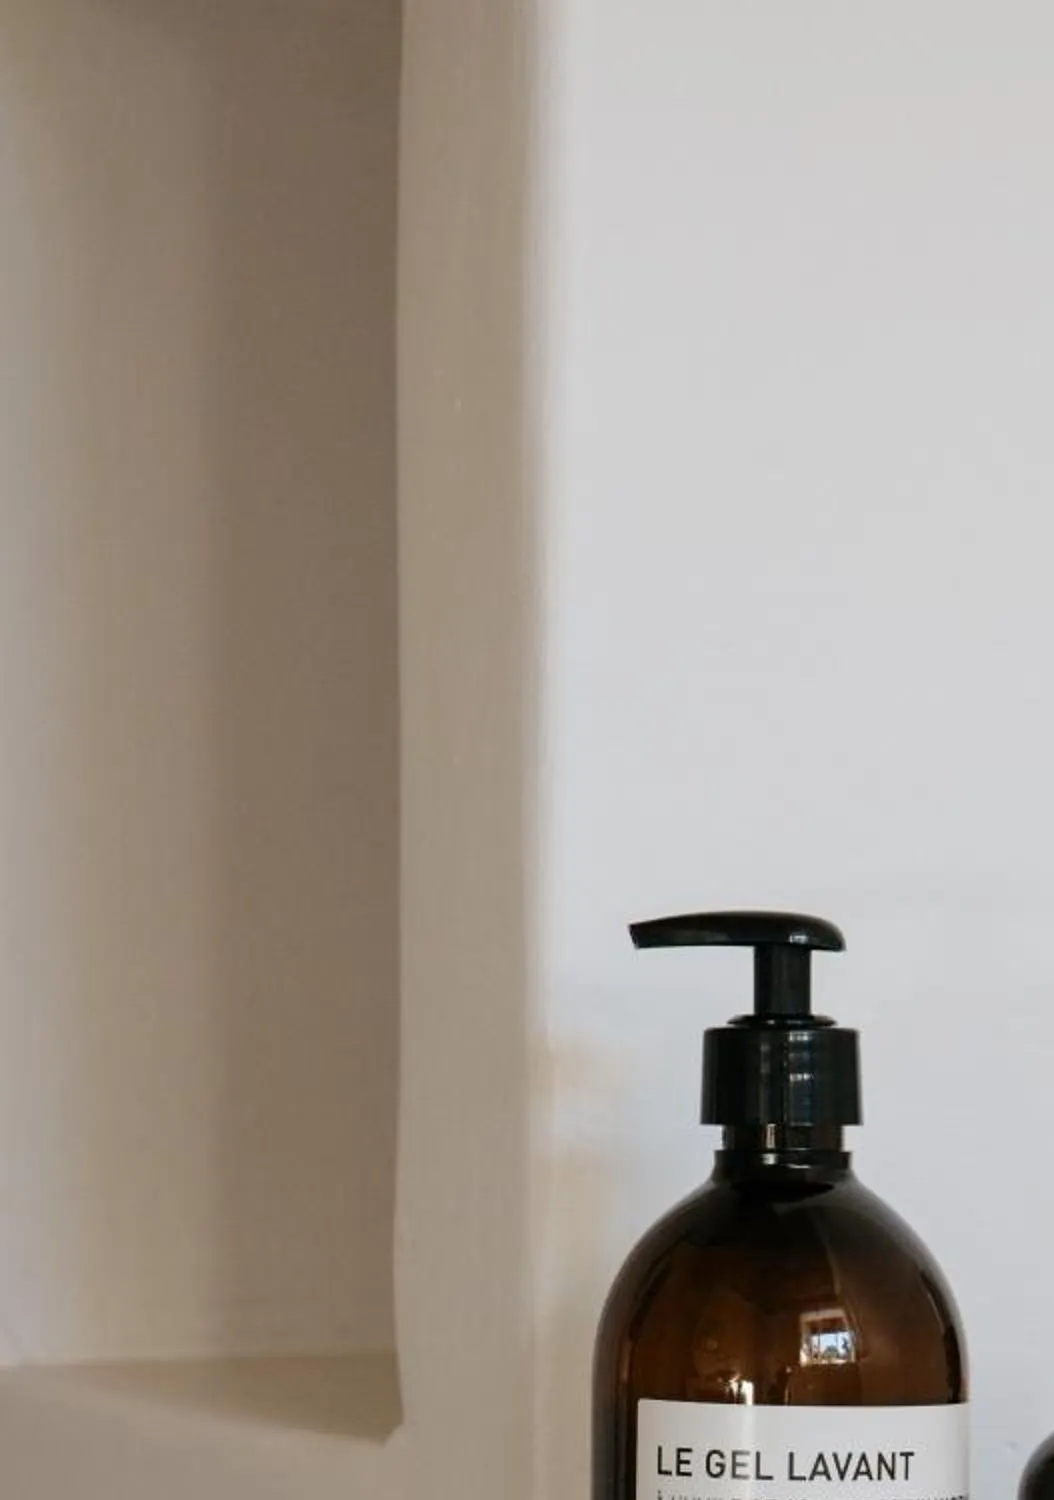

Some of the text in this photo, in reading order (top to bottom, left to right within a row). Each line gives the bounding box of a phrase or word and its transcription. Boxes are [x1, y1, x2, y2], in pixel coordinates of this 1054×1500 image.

[657, 1445, 915, 1482] LE GEL LAVANT
